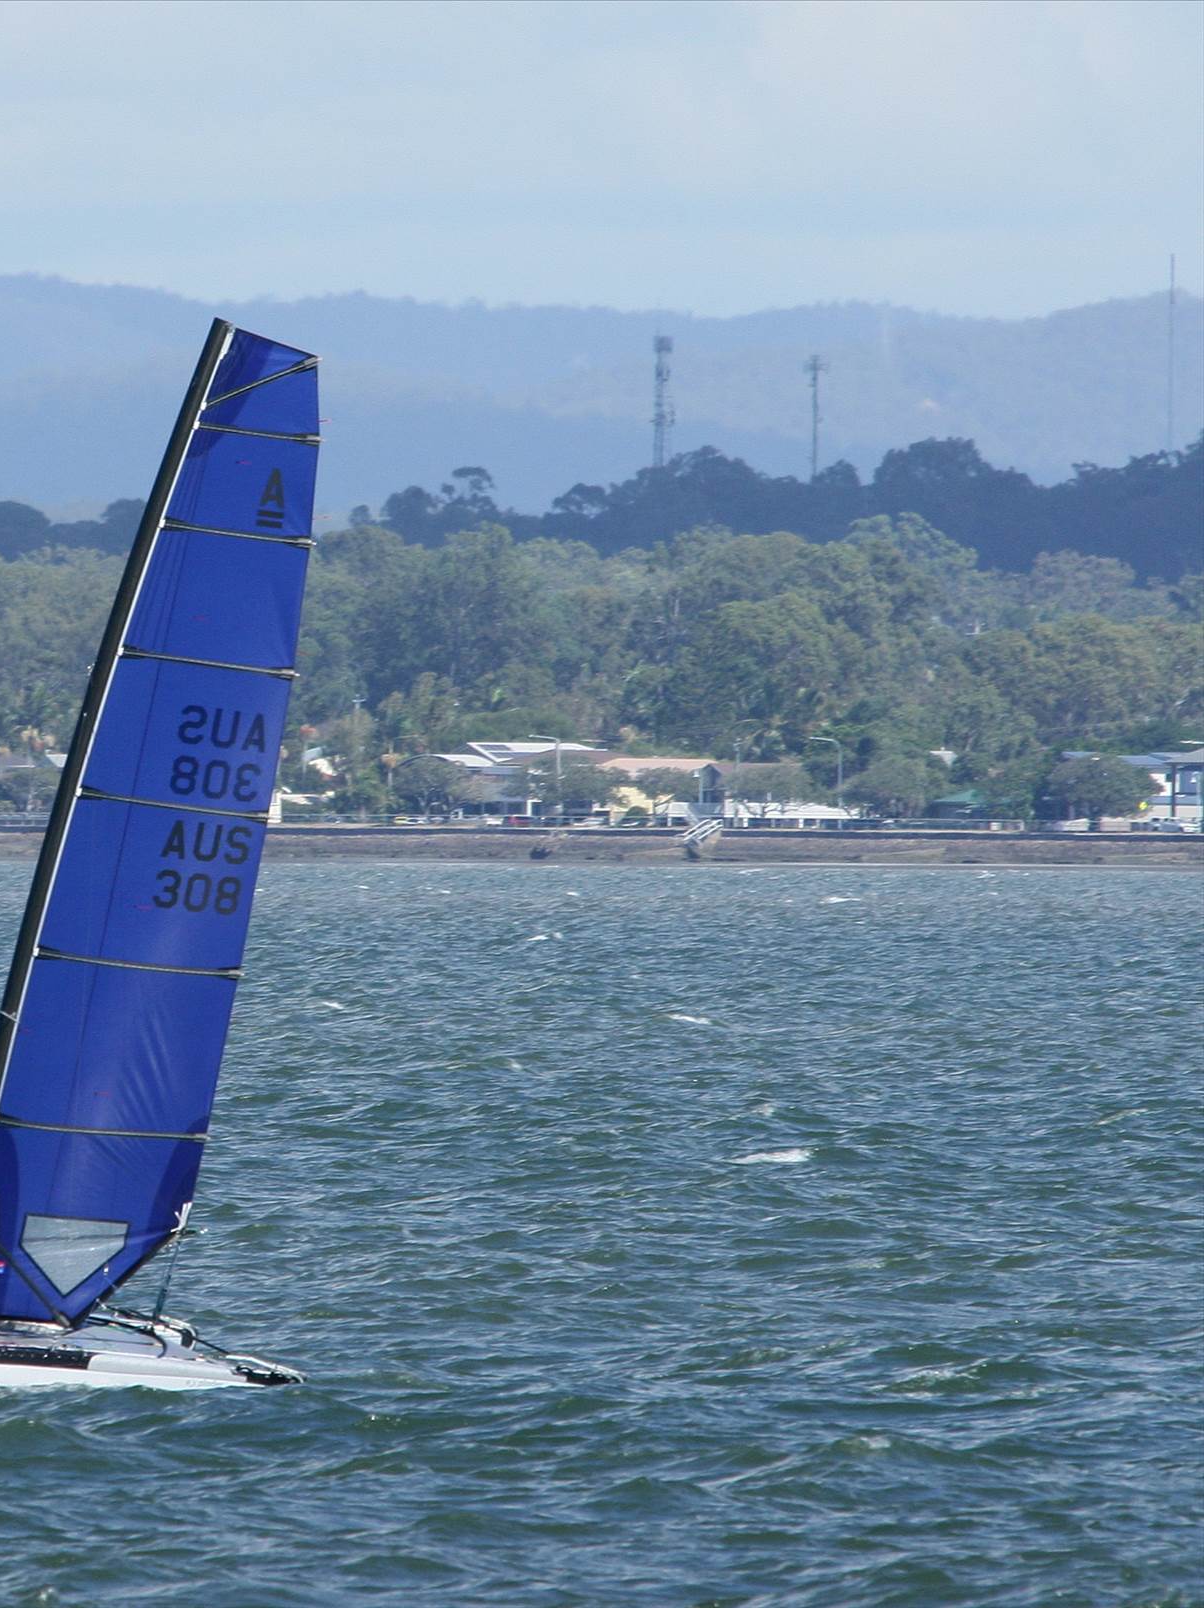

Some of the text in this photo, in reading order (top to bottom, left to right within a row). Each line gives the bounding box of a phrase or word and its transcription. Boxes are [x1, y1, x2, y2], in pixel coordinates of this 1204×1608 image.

[259, 467, 285, 509] A
[160, 820, 252, 865] AUS
[153, 870, 242, 915] 308
